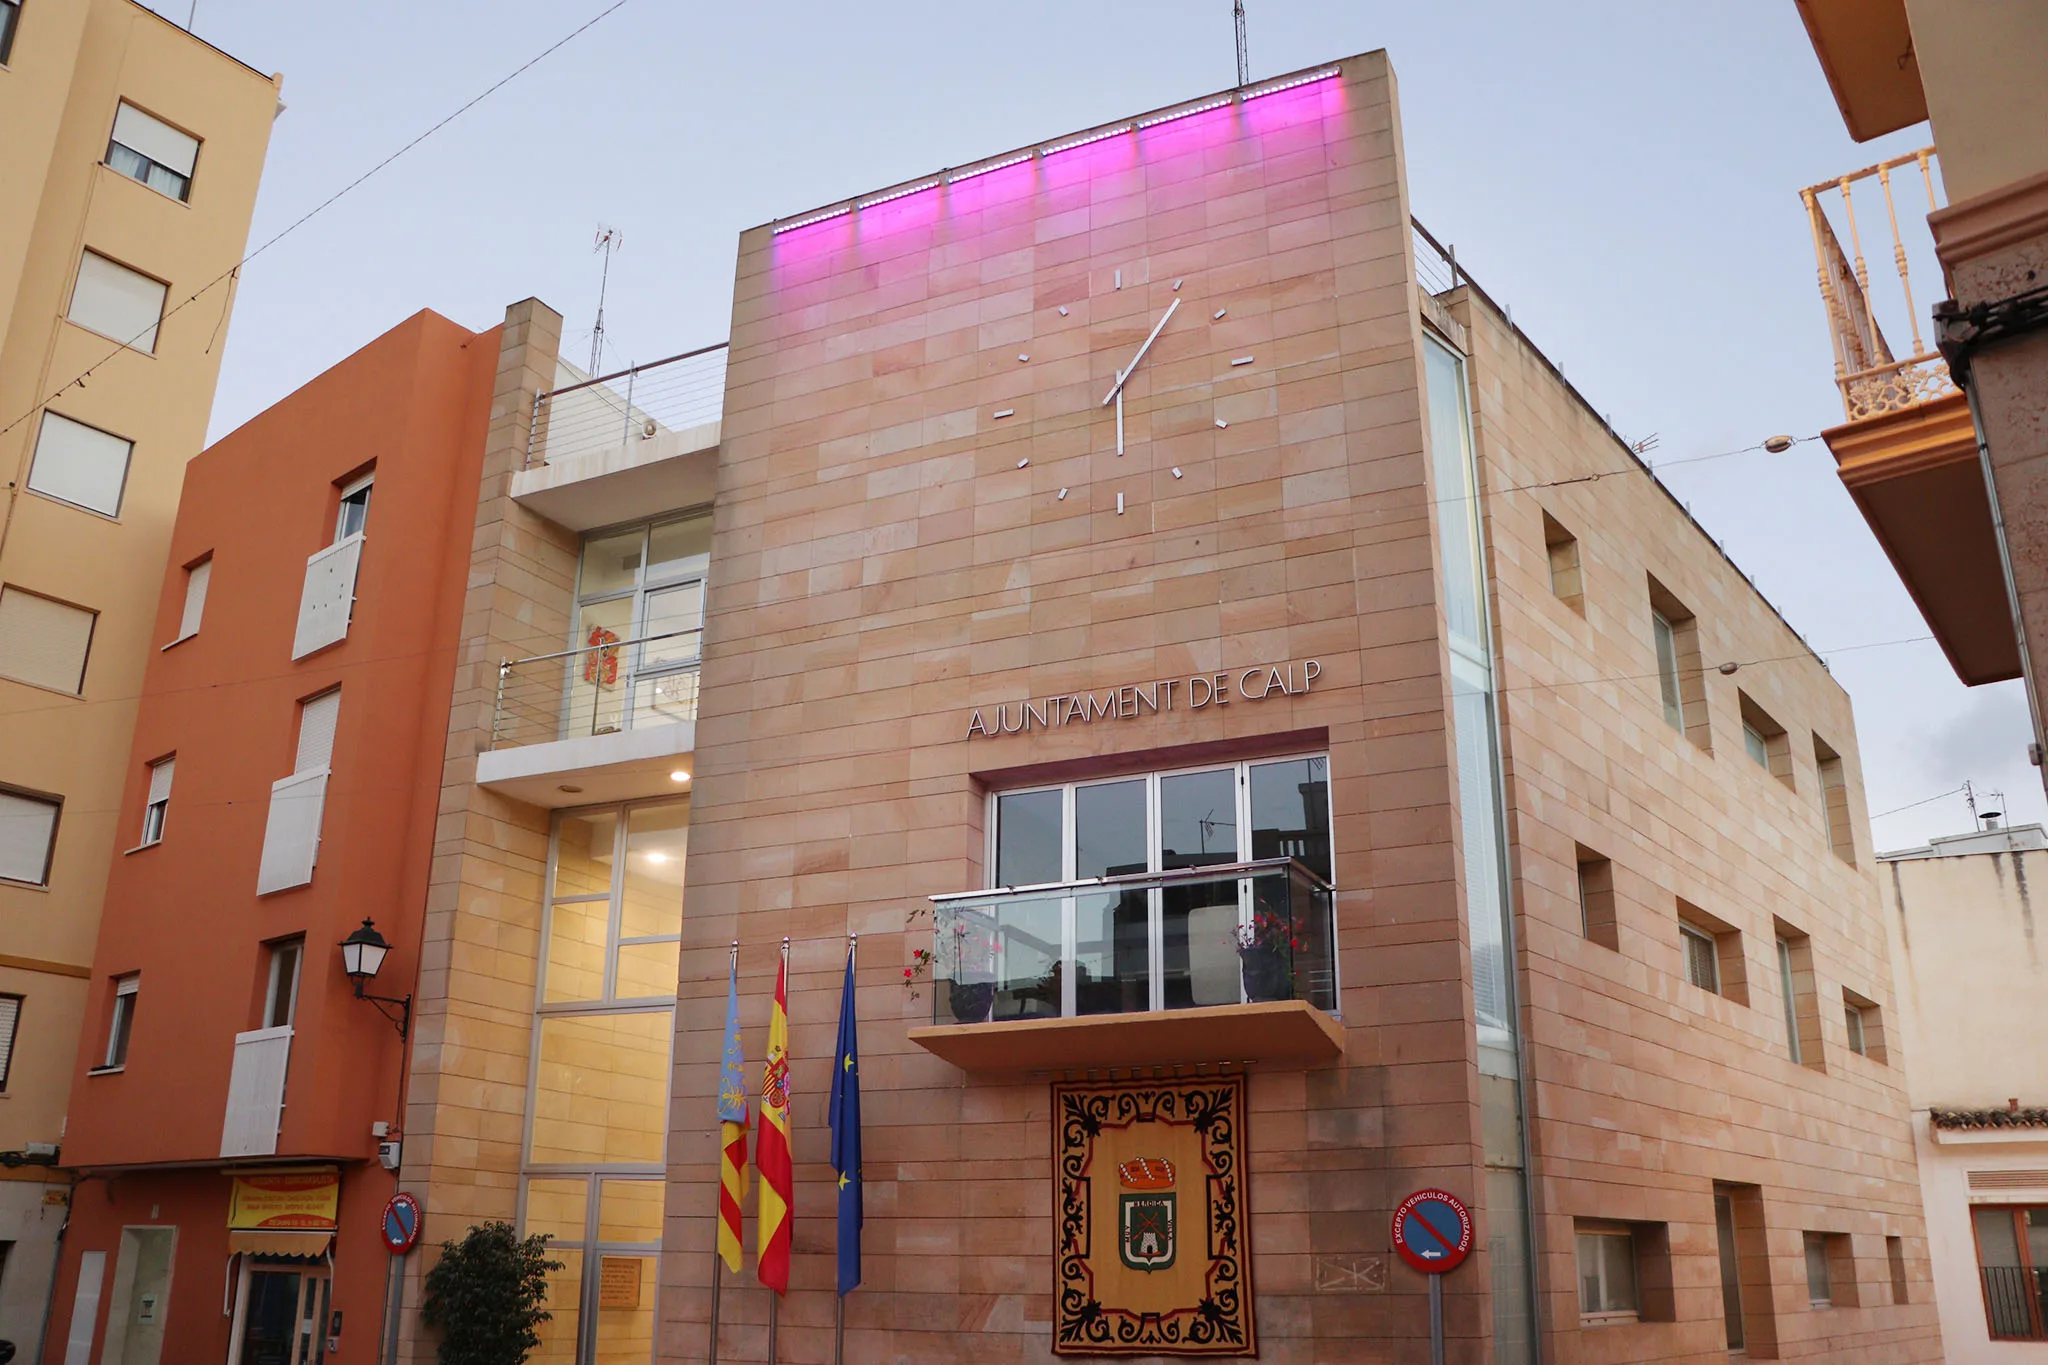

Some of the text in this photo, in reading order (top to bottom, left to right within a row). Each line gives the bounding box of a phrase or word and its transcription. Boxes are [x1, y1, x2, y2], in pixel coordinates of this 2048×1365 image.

[966, 660, 1322, 738] AJUNTAMENT DE CALP
[1394, 1192, 1470, 1252] EXCEPTO VEHICULOS AUTORIZADOS
